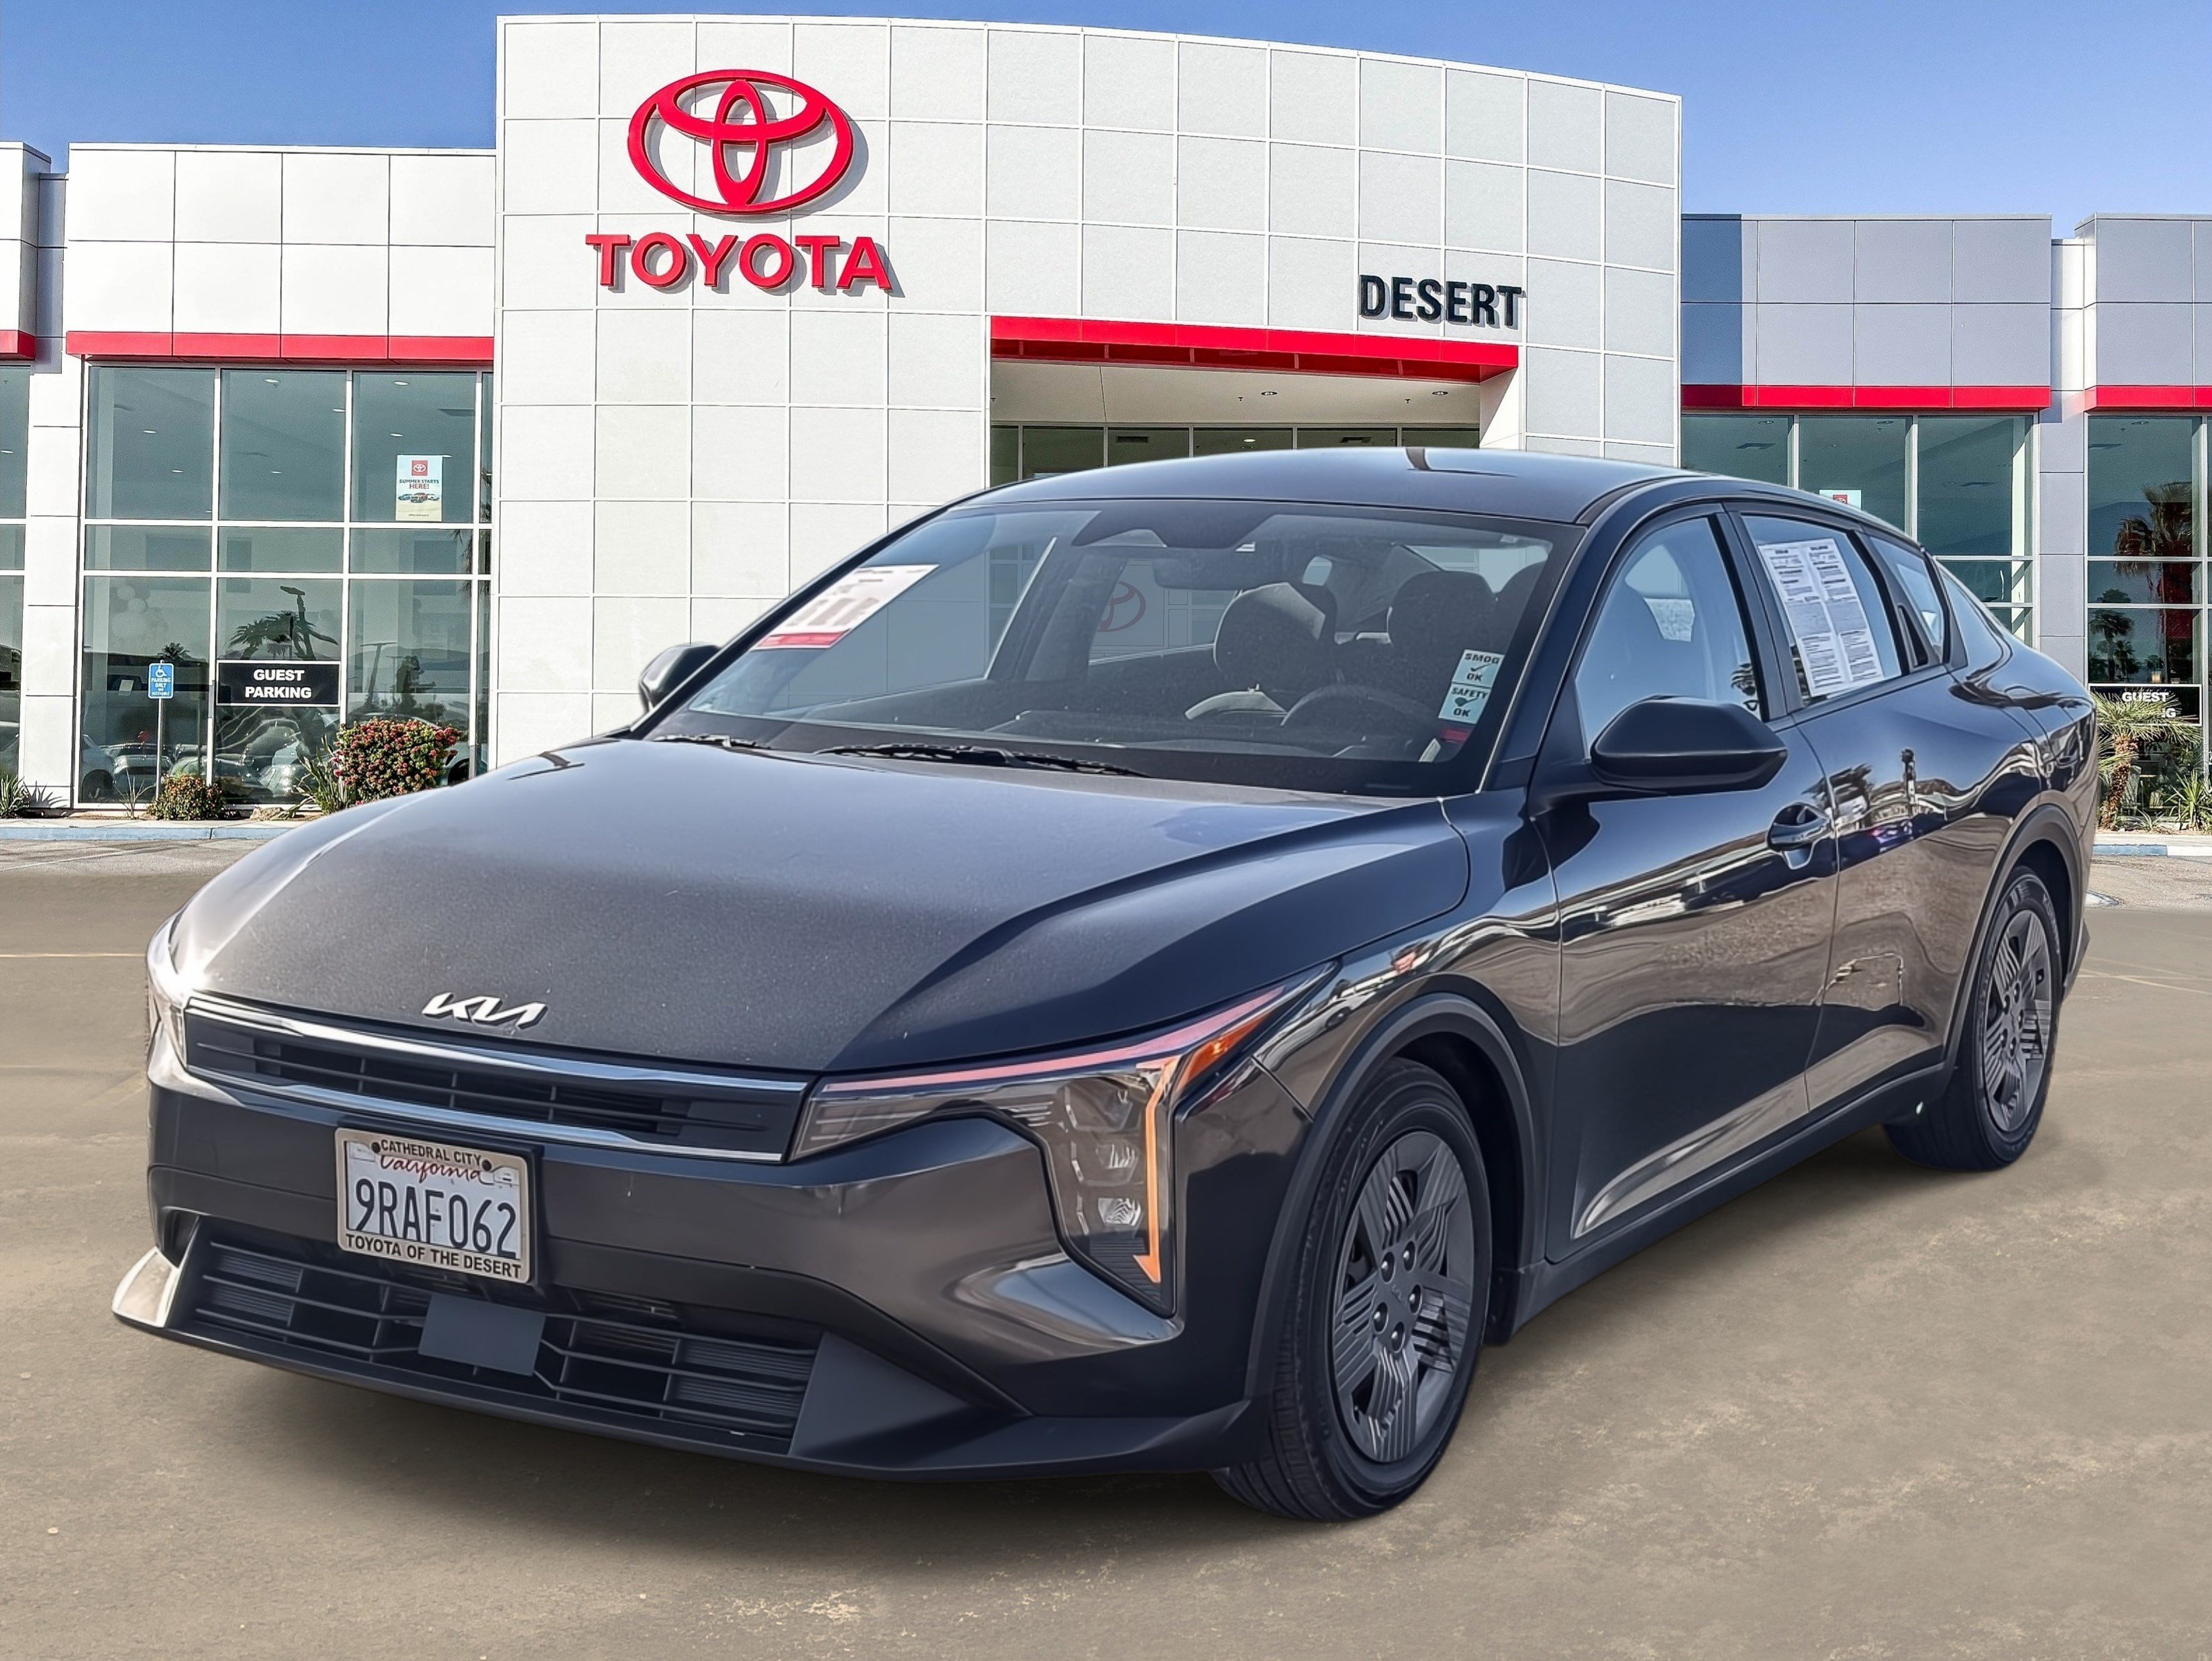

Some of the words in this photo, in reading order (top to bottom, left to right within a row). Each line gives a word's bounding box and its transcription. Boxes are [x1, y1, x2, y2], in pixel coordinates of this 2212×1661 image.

[585, 232, 893, 291] TOYOTA
[1359, 274, 1522, 327] DESERT
[1464, 653, 1500, 664] SMOG
[253, 669, 305, 681] GUEST
[1466, 672, 1482, 682] OK
[245, 686, 312, 699] PARKING
[1452, 687, 1488, 699] SAFETY
[2121, 691, 2169, 703] GUEST
[1454, 708, 1470, 717] OK
[421, 992, 548, 1029] KIA
[381, 1139, 450, 1162] CATHEDRAL
[454, 1151, 482, 1166] CITY
[380, 1154, 495, 1185] California
[355, 1178, 517, 1259] 9RAF062
[346, 1234, 402, 1256] TOYOTA
[407, 1244, 426, 1260] OF
[430, 1248, 460, 1266] THE
[463, 1255, 521, 1279] DESERT
